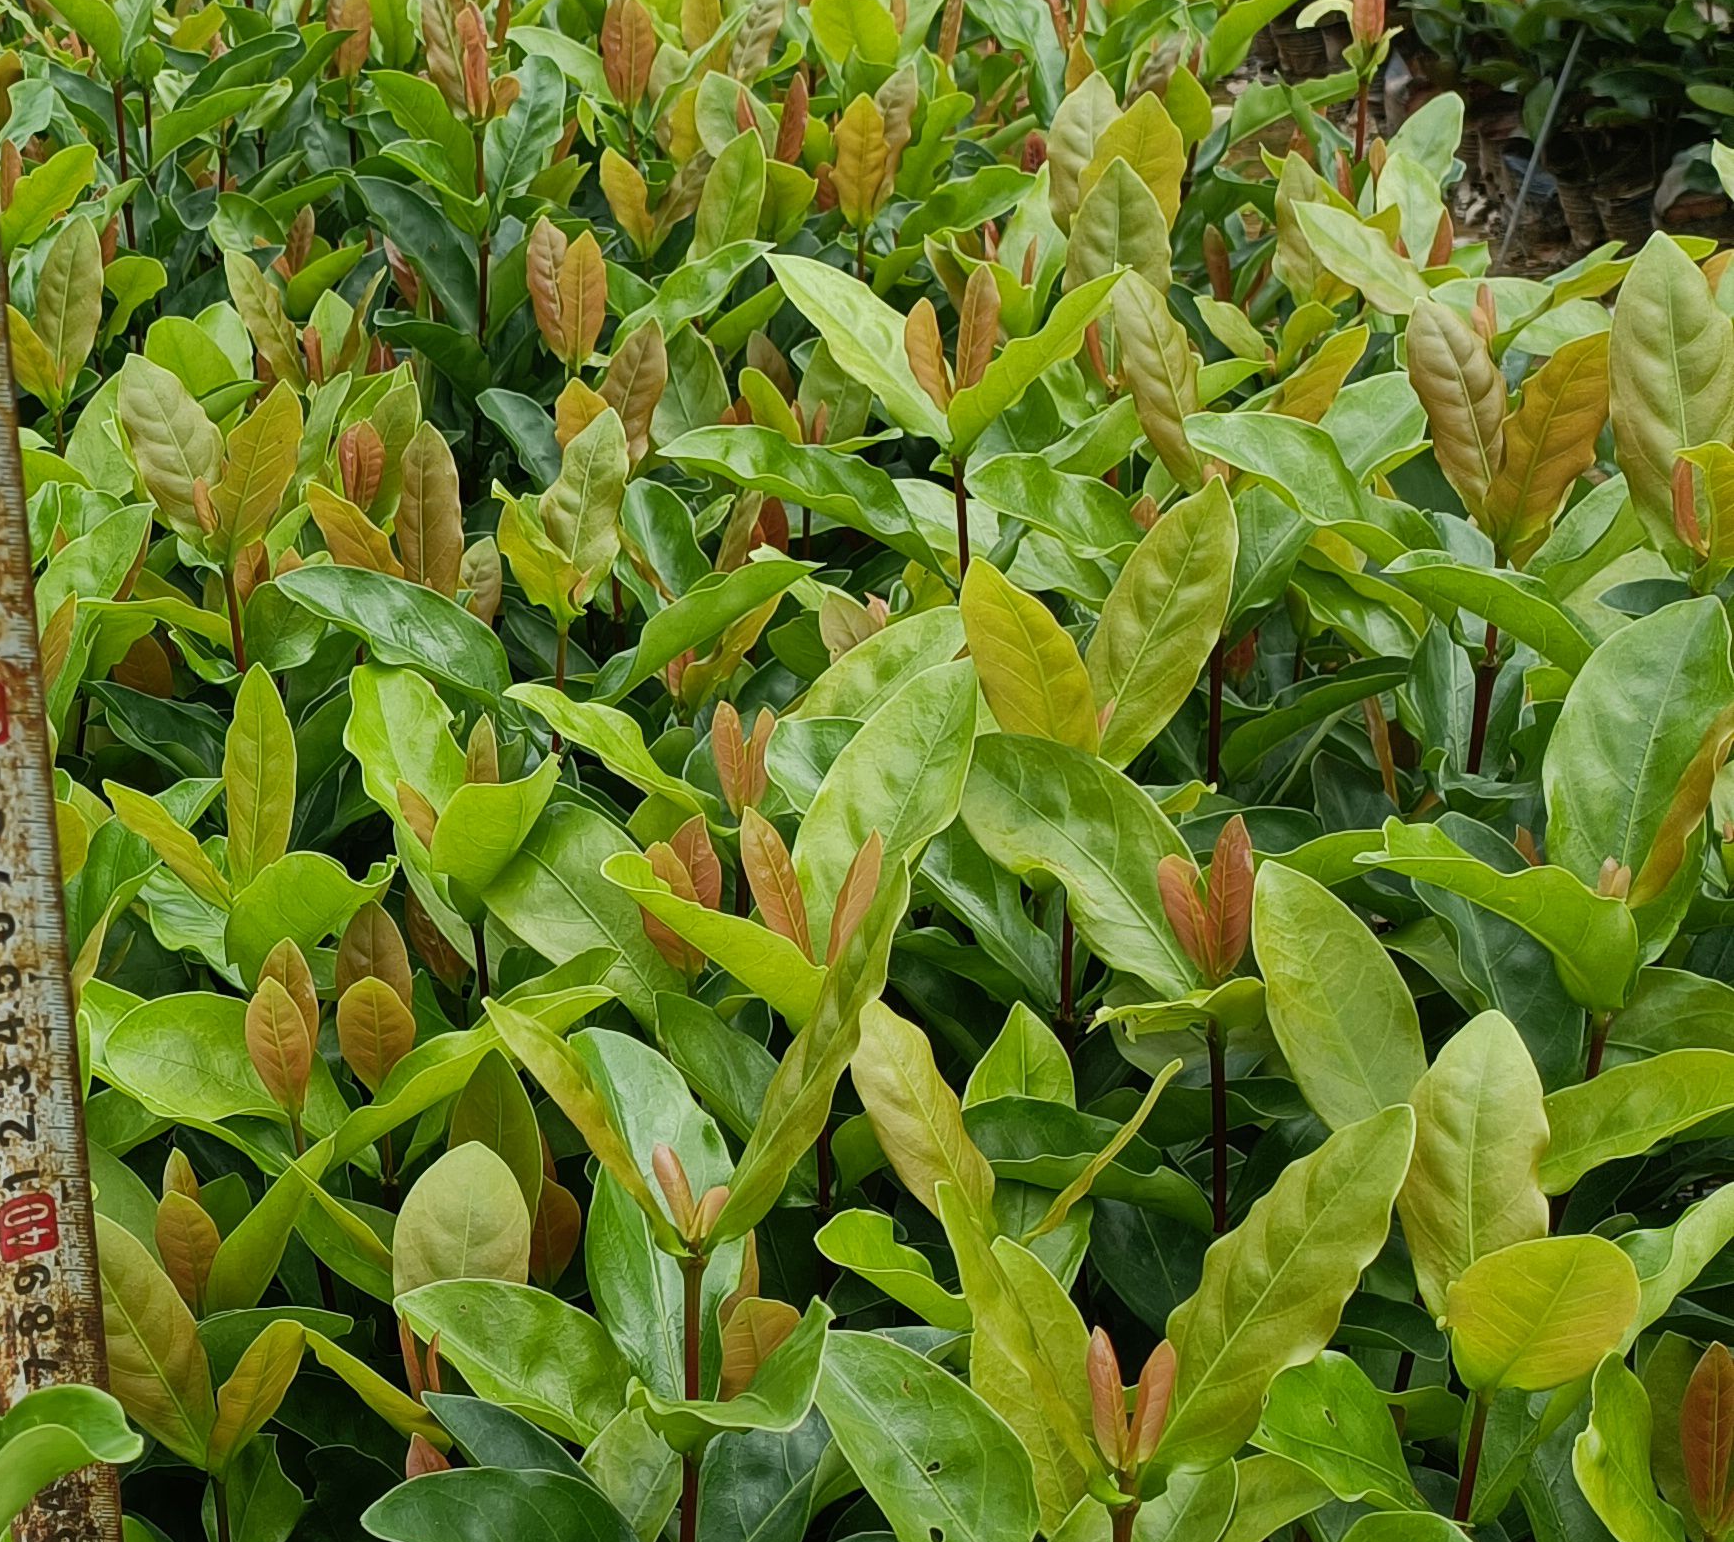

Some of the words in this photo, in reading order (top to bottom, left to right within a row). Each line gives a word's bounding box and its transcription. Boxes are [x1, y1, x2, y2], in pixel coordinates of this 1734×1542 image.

[2, 1169, 39, 1192] 1
[3, 1202, 51, 1247] 40
[13, 1263, 51, 1295] 9
[18, 1304, 55, 1337] 8
